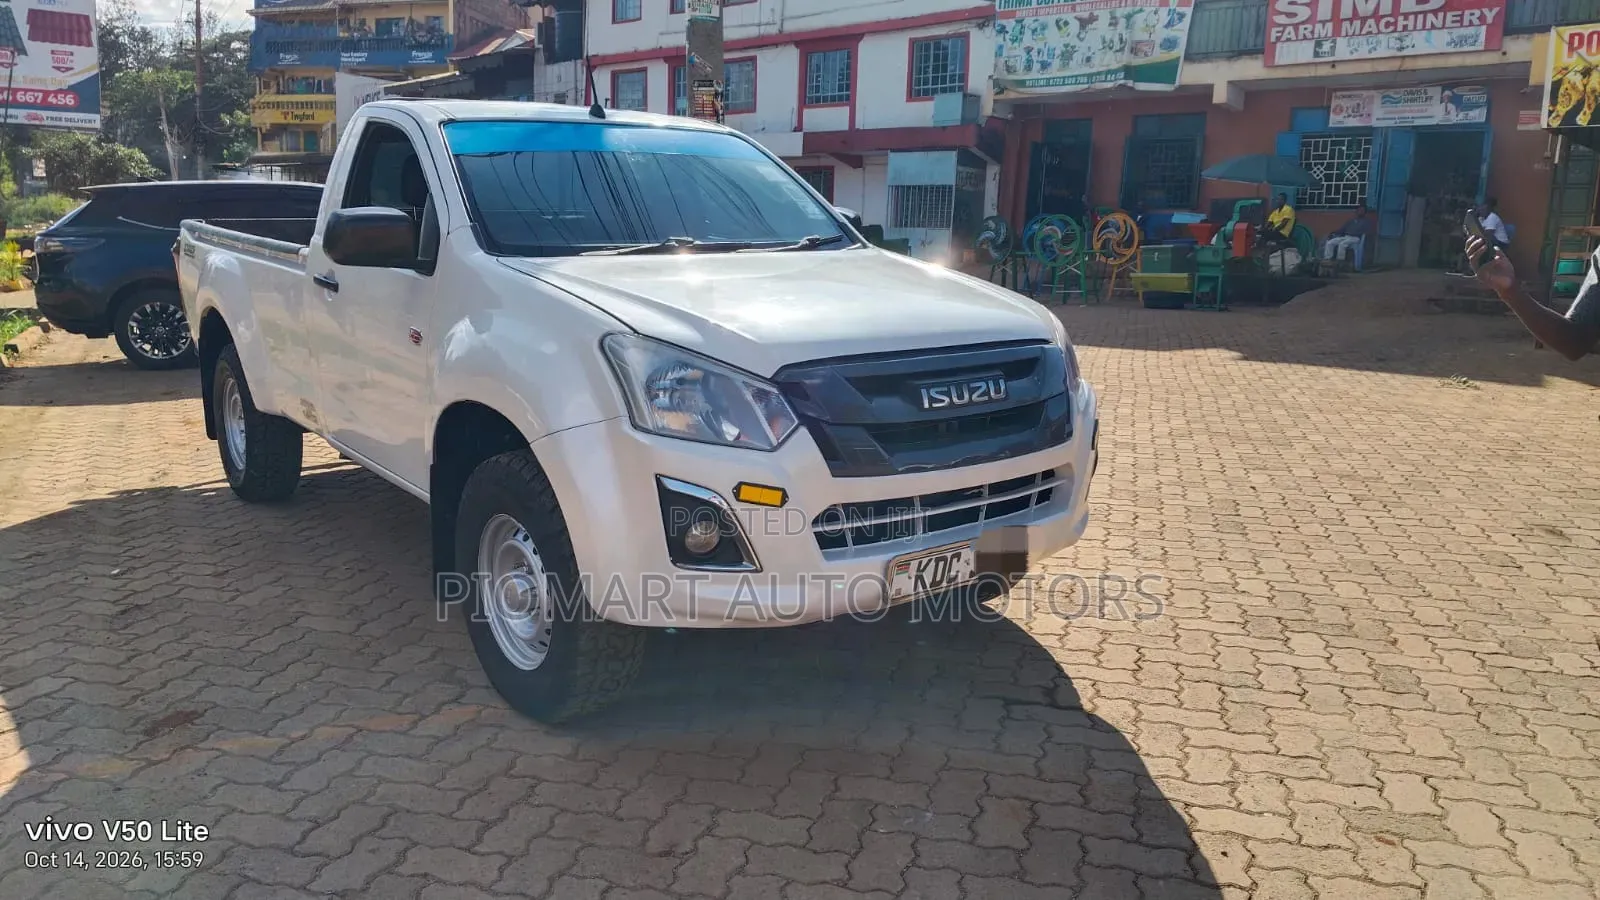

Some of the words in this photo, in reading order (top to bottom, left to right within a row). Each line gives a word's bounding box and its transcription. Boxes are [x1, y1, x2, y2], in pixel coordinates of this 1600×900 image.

[1270, 22, 1333, 43] FARM
[1340, 6, 1502, 37] MACHINERY
[16, 91, 43, 103] 667
[48, 94, 75, 105] 456
[920, 379, 1007, 409] ISUZU
[912, 551, 962, 592] KDC
